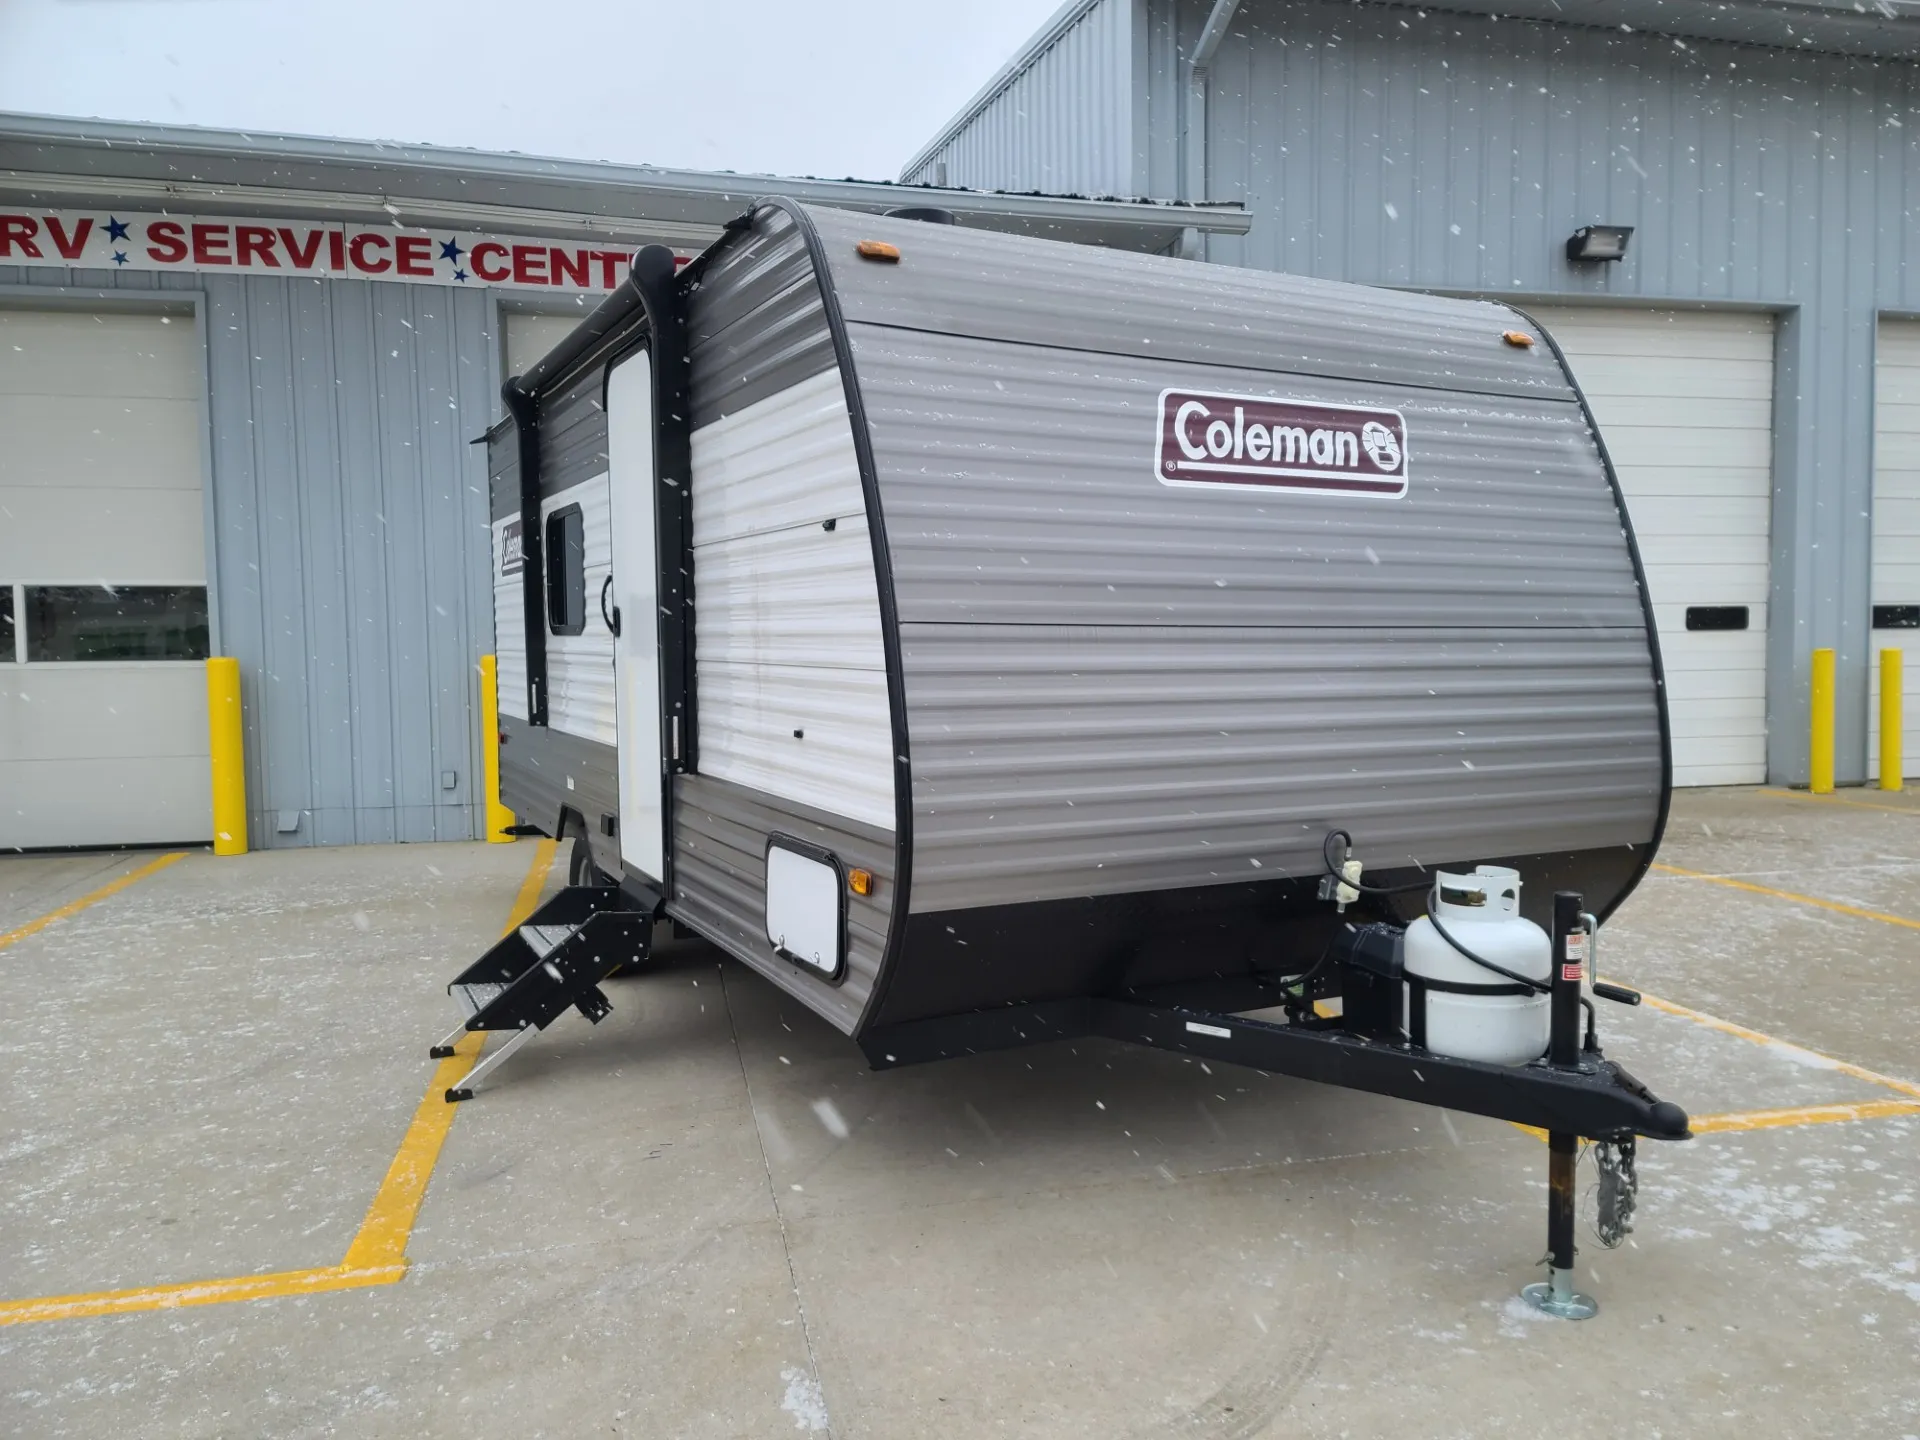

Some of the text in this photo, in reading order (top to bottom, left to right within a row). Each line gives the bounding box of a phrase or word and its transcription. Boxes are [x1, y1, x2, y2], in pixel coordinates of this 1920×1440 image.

[0, 214, 694, 289] RV SERVICE CENT
[1174, 400, 1358, 467] Coleman
